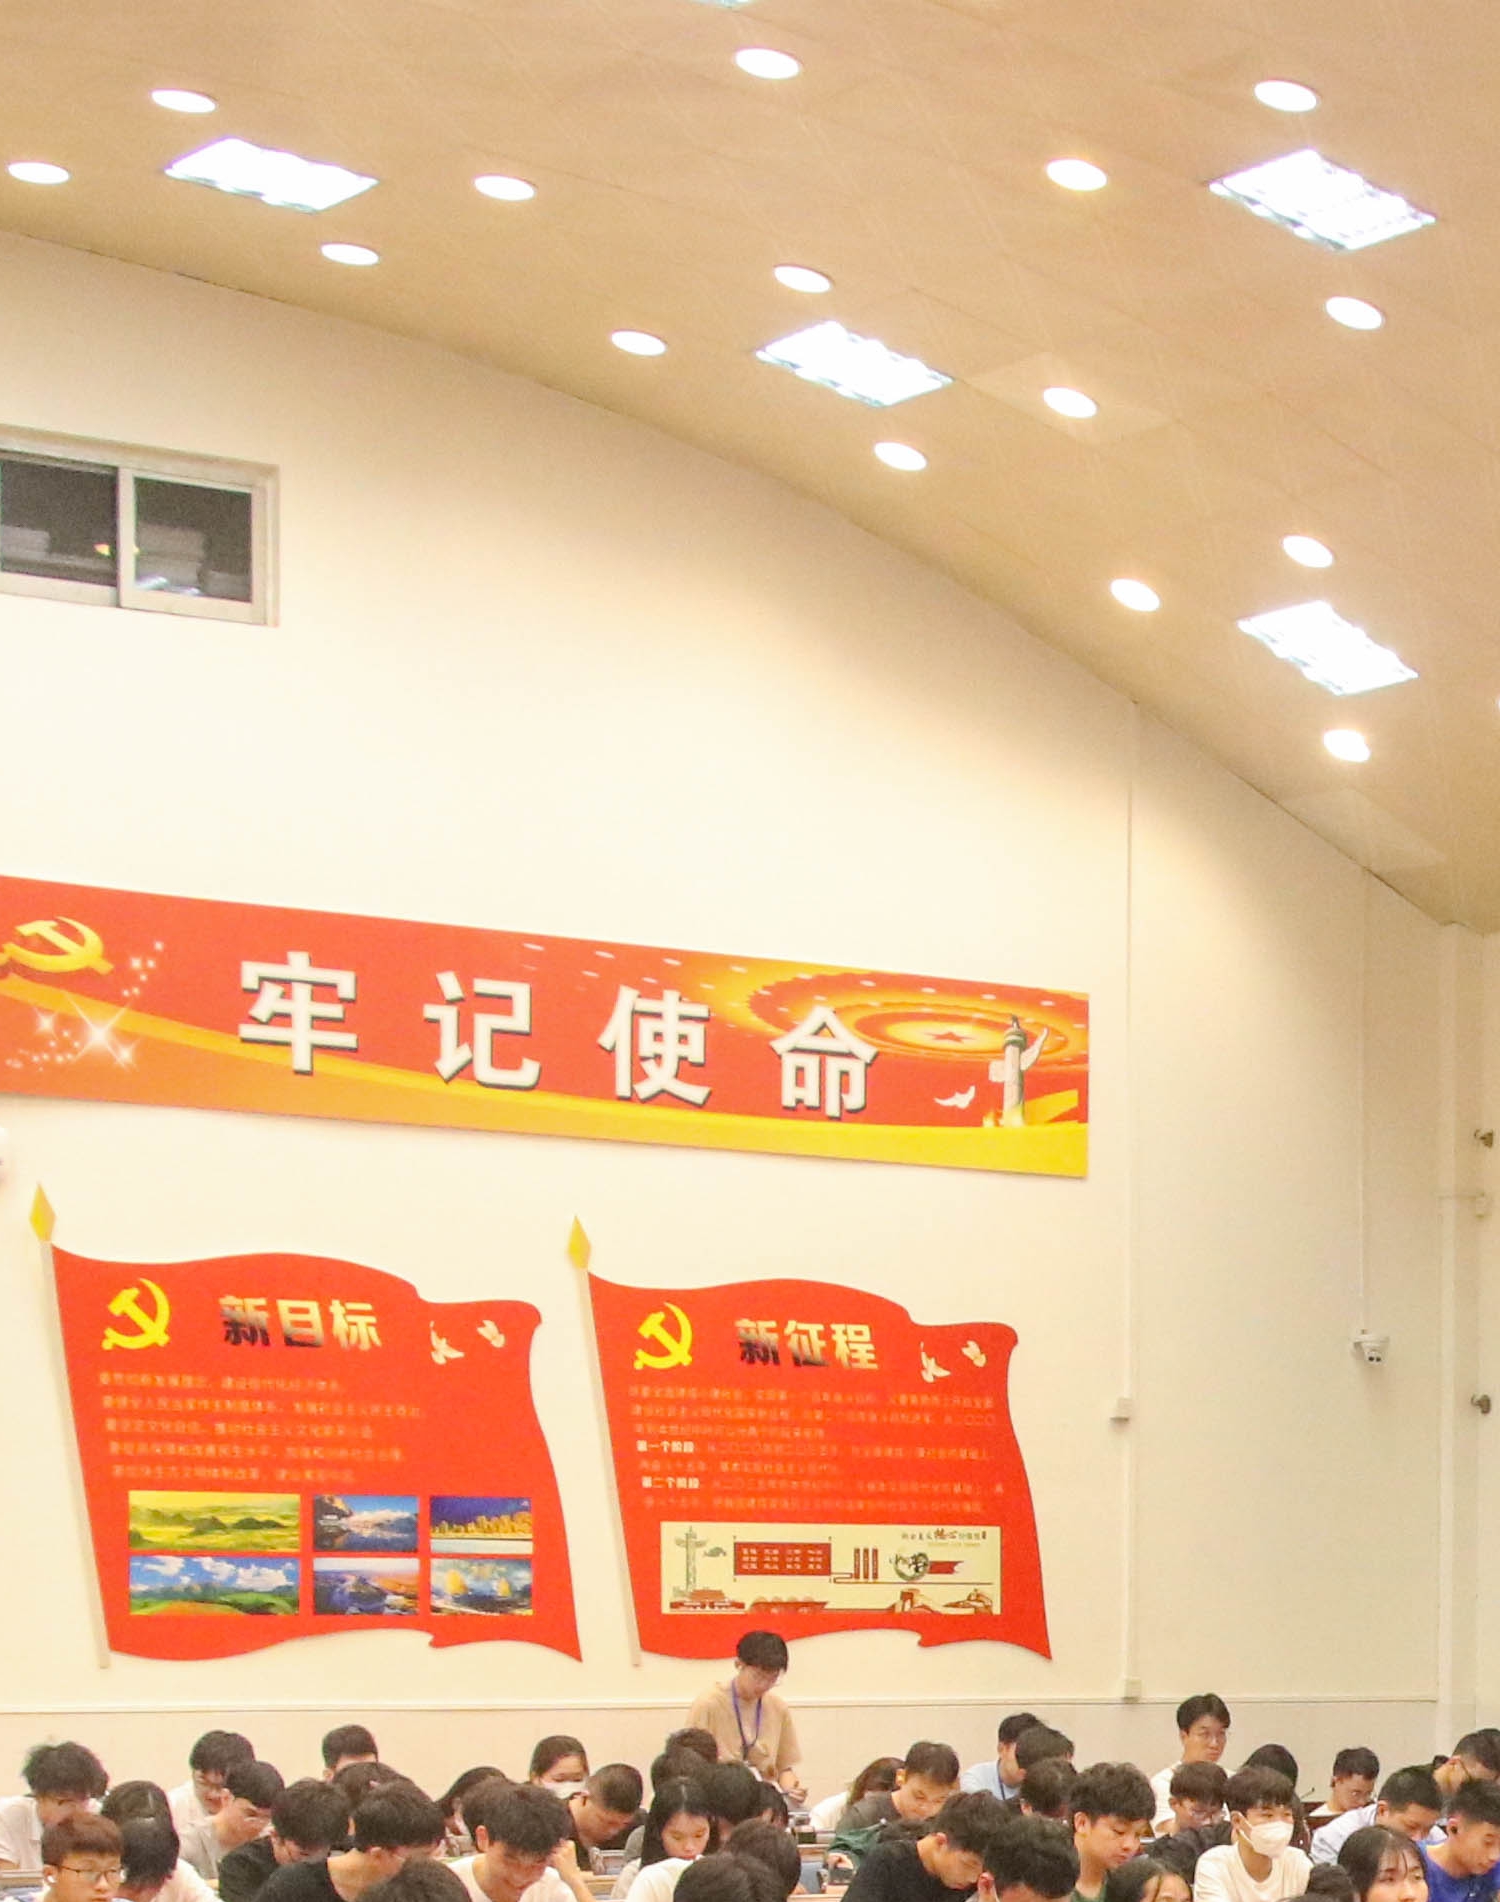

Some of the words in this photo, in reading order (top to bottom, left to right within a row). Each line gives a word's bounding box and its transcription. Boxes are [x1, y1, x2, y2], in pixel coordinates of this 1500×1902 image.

[237, 949, 881, 1119] 牢记使命
[219, 1295, 382, 1351] 新目标
[734, 1318, 879, 1370] 新征程
